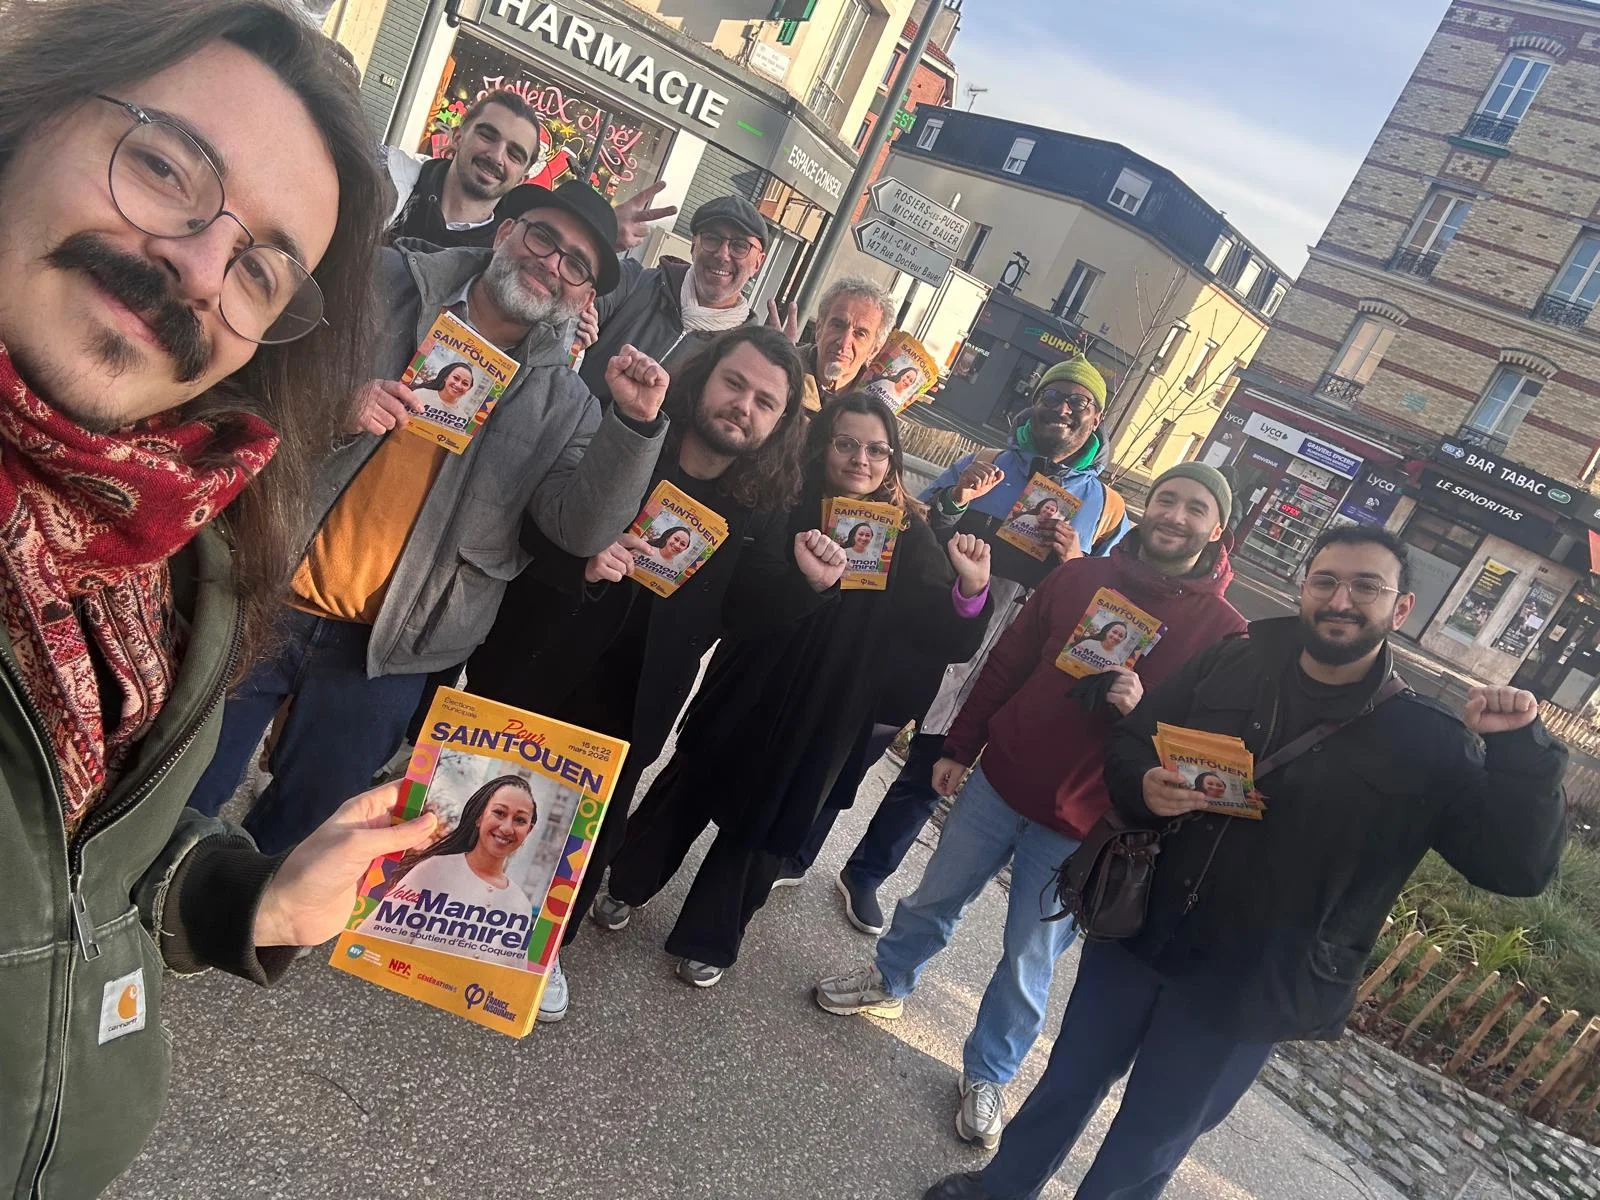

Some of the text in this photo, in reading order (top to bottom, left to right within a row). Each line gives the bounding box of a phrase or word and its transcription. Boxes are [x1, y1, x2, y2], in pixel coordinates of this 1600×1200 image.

[788, 144, 842, 199] ESPACE CONSEIL
[891, 203, 960, 247] MICHELET BAUER
[866, 238, 941, 282] 147 Rue Docteur Bauer
[1224, 411, 1245, 425] Lyca
[1259, 423, 1283, 438] Lyca
[1366, 472, 1396, 492] Lyca
[1465, 454, 1496, 474] BAR
[1499, 467, 1547, 495] TABAC
[1436, 479, 1453, 490] LE
[1451, 486, 1524, 521] SENORITAS
[632, 556, 682, 580] onmirel
[638, 554, 678, 576] Manon
[500, 719, 549, 748] Pour
[581, 740, 612, 756] 15 et 22
[430, 721, 604, 795] SAINT-OUEN
[567, 743, 610, 762] mars 2026
[415, 888, 530, 932] Manon
[374, 900, 536, 951] Monmirel
[373, 923, 398, 934] avec
[399, 926, 409, 937] le
[409, 930, 447, 945] soutien
[479, 943, 526, 960] Coquerel
[482, 1000, 517, 1022] INSOUMISE
[486, 994, 510, 1011] FRANCE
